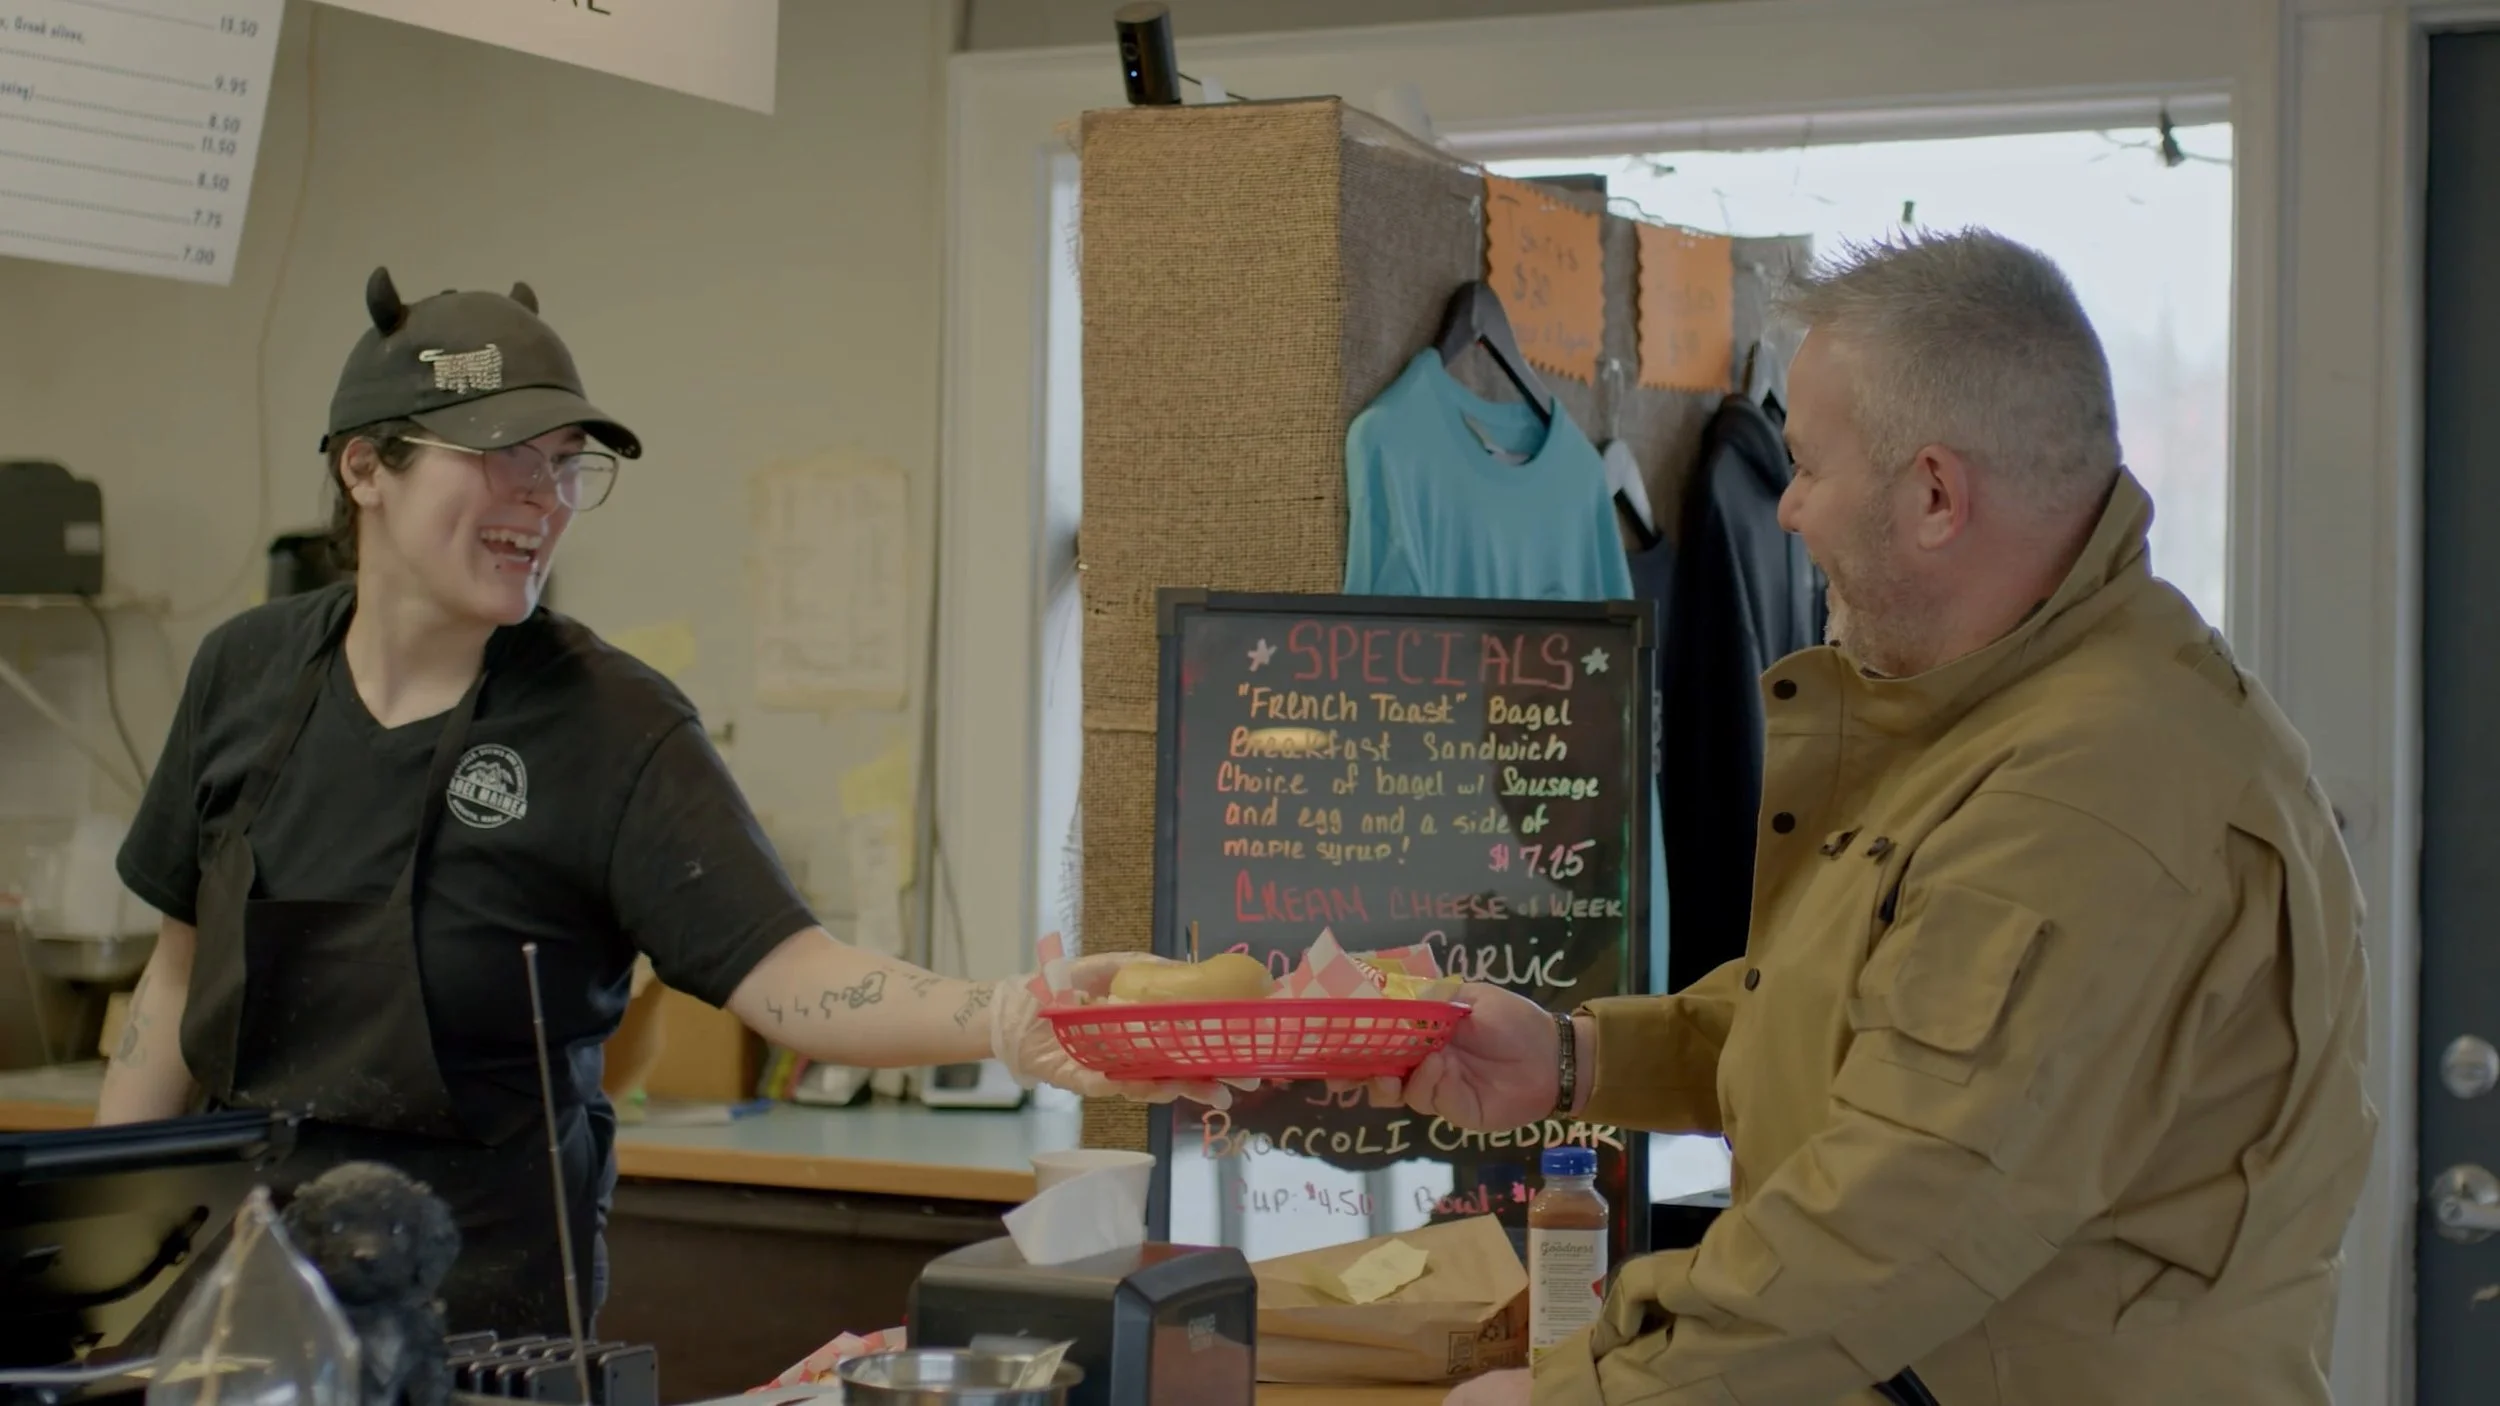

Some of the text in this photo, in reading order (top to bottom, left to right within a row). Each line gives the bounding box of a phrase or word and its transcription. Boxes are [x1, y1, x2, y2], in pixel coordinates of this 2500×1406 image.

[1288, 619, 1575, 691] SPECIALS
[1488, 695, 1573, 727] Bagel
[1423, 735, 1568, 762] Sandwich
[1217, 761, 1308, 795] Choice
[1332, 767, 1359, 796] of
[1376, 767, 1444, 798] bagel
[1500, 771, 1600, 800] Sausage
[1224, 799, 1550, 835] and egg and a side of
[1234, 868, 1369, 922] CREAM
[1389, 886, 1509, 920] CHEESE
[1551, 890, 1623, 918] WEEK
[1201, 1109, 1412, 1161] BROCCOLI
